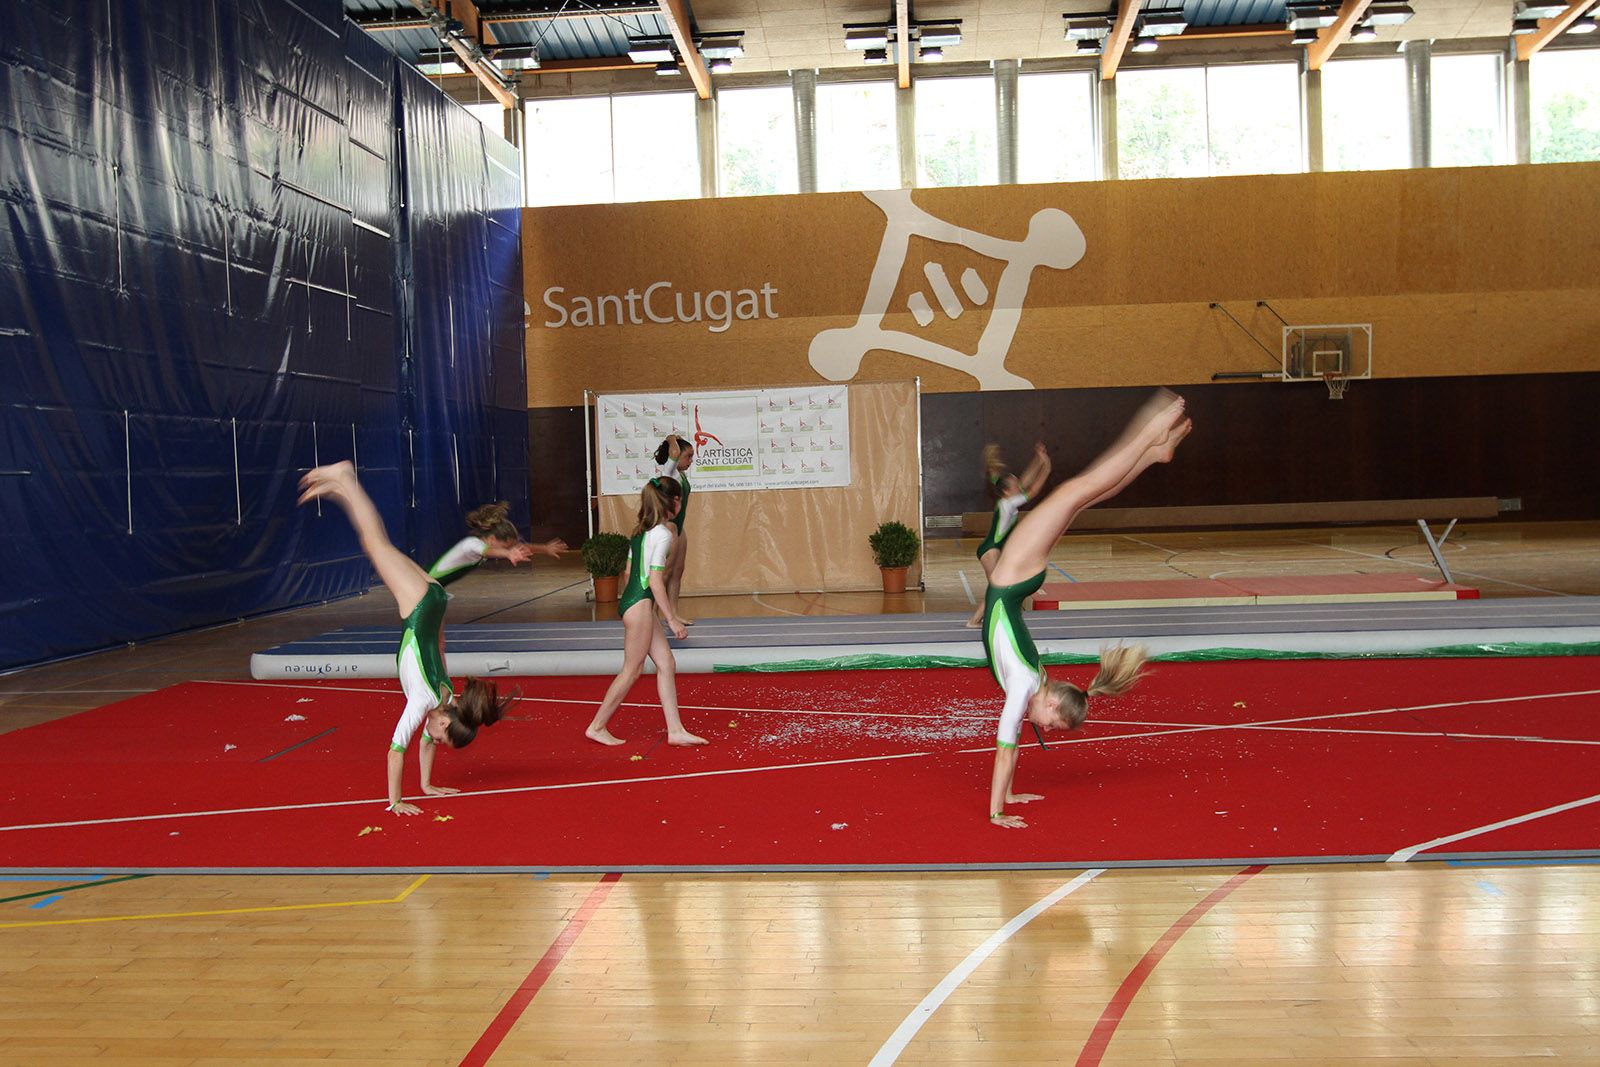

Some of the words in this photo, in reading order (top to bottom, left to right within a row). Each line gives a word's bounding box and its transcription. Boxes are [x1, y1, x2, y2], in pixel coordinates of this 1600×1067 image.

[543, 281, 779, 333] SantCugat
[696, 458, 719, 466] SANT
[722, 457, 752, 465] CUGAT
[285, 663, 358, 676] airgym.eu
